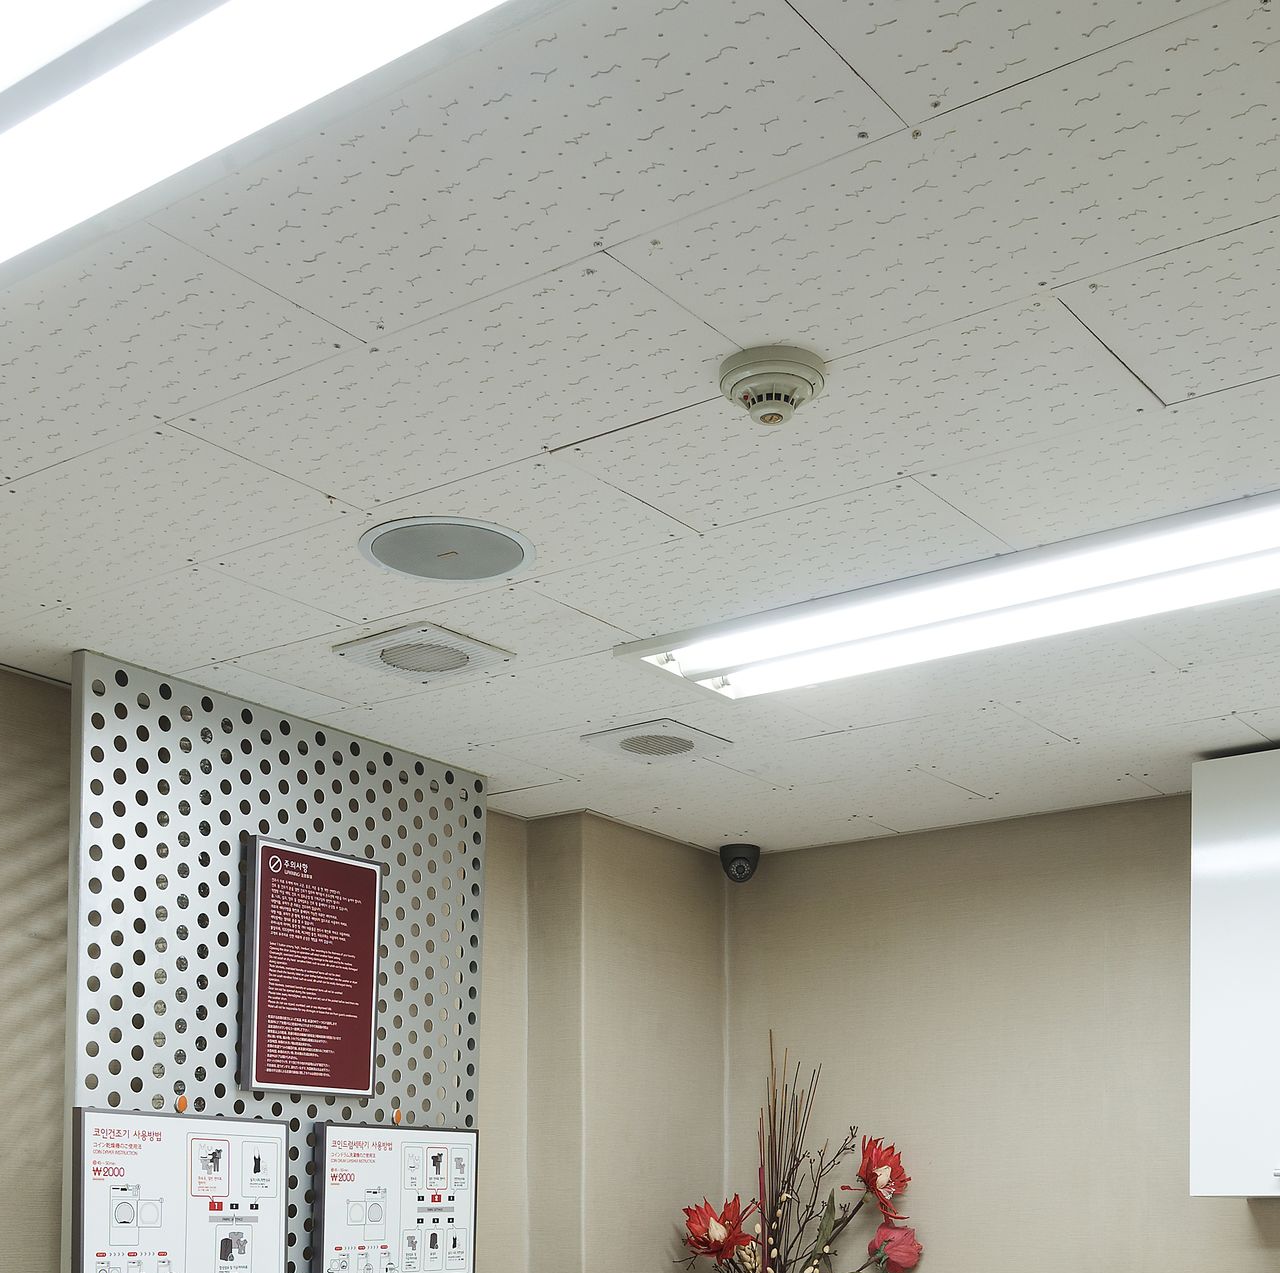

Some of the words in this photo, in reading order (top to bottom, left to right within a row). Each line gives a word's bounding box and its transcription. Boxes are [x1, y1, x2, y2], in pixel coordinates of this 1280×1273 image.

[284, 860, 308, 873] 주의사항
[93, 1128, 130, 1140] 코인건조기
[133, 1130, 162, 1142] 사용방법
[331, 1140, 369, 1150] 코인드럼세탁기
[372, 1141, 392, 1151] 사용방법
[92, 1166, 125, 1177] ₩2000
[331, 1173, 355, 1182] ₩2000
